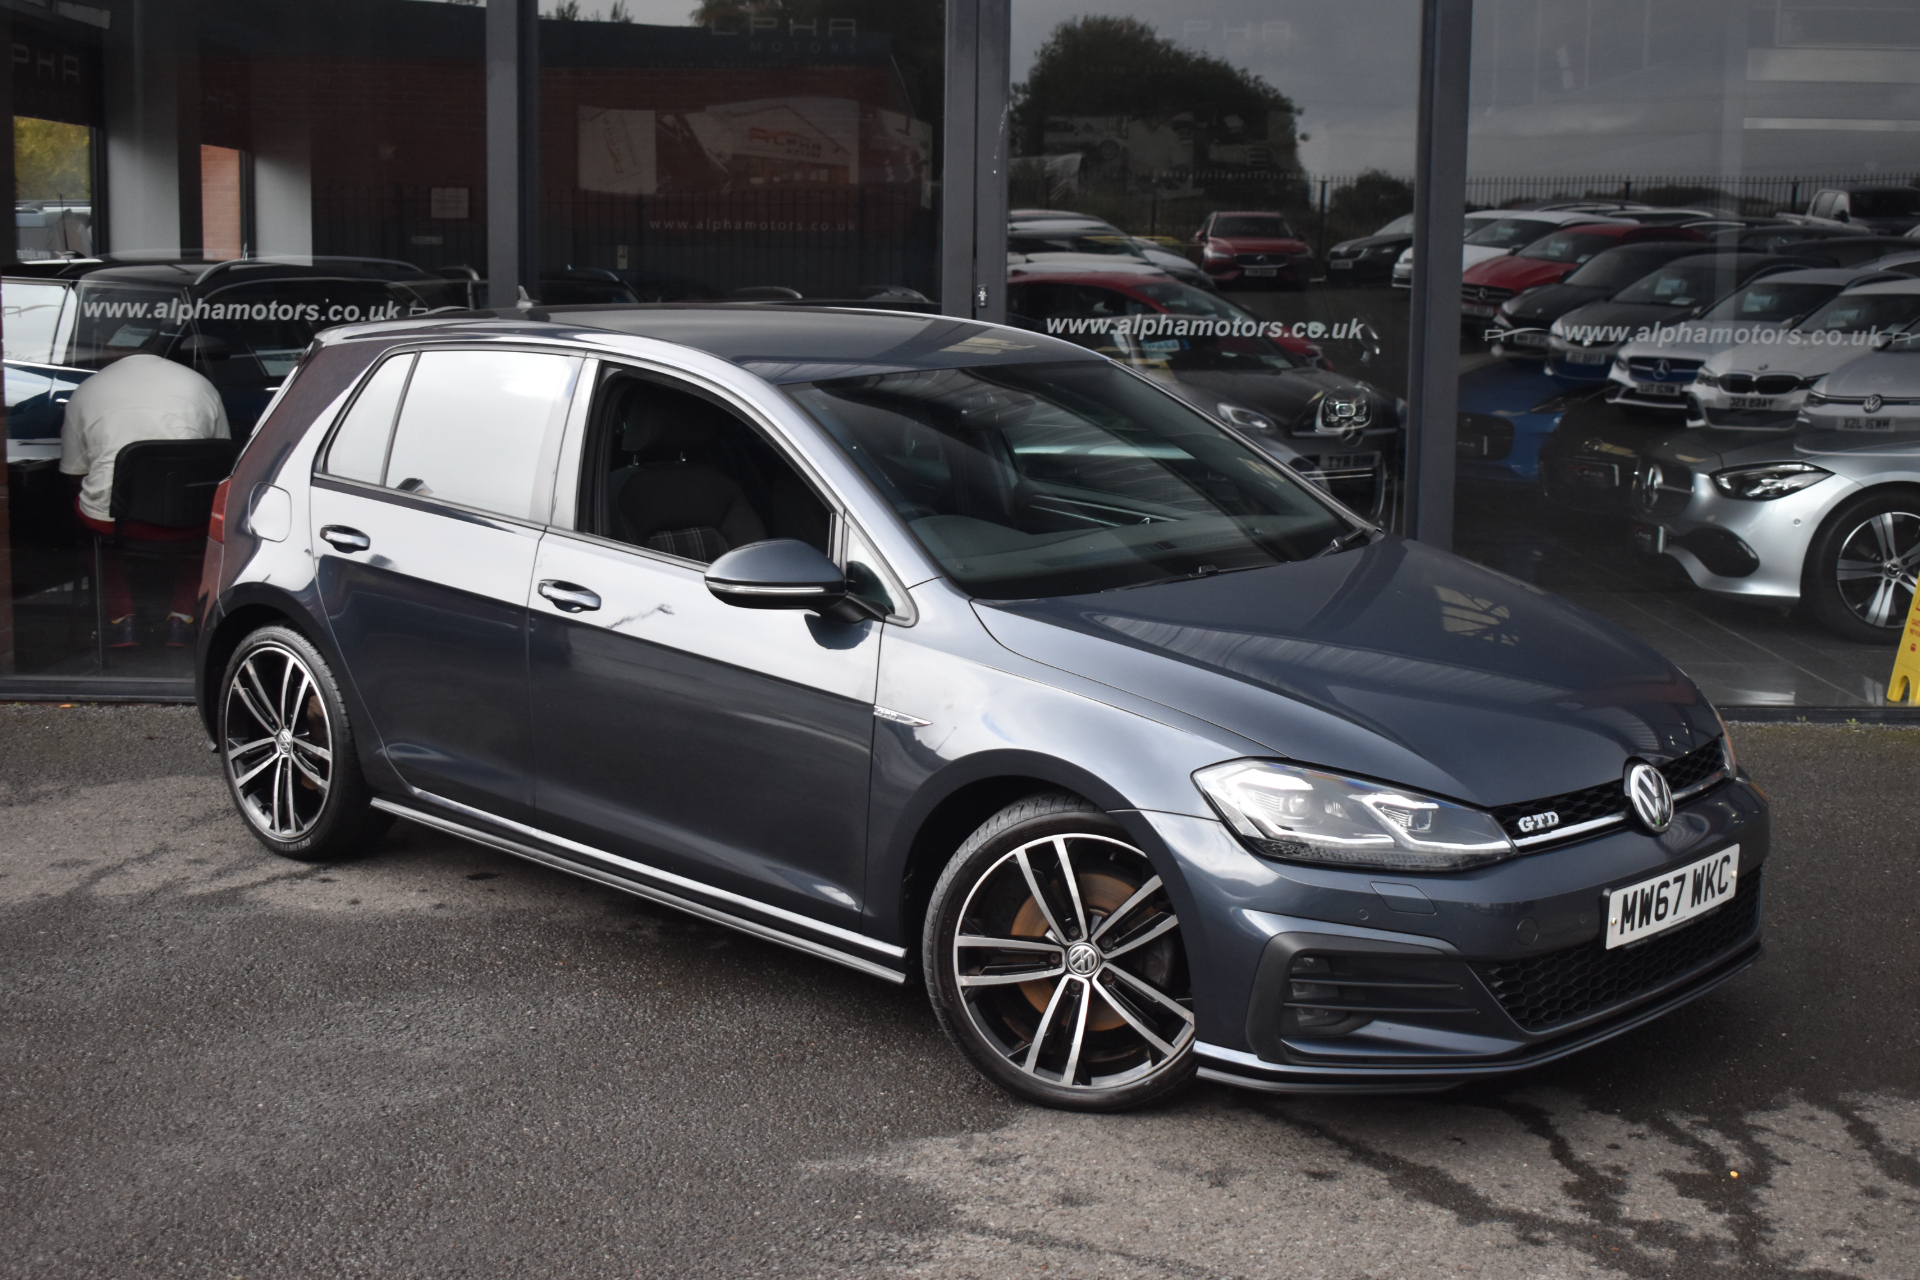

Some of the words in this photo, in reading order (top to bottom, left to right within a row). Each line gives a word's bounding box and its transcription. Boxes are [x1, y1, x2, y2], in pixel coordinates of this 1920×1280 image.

[749, 41, 857, 54] MOTORS
[649, 218, 857, 232] www.alphamotors.co.uk
[83, 299, 401, 325] www.alphamotors.co.uk
[1046, 314, 1365, 340] www.alphamotors.co.uk
[1564, 321, 1883, 347] www.alphamotors.co.uk
[1518, 811, 1559, 833] GTD
[1619, 873, 1687, 936] MW67
[1690, 855, 1731, 908] WKC
